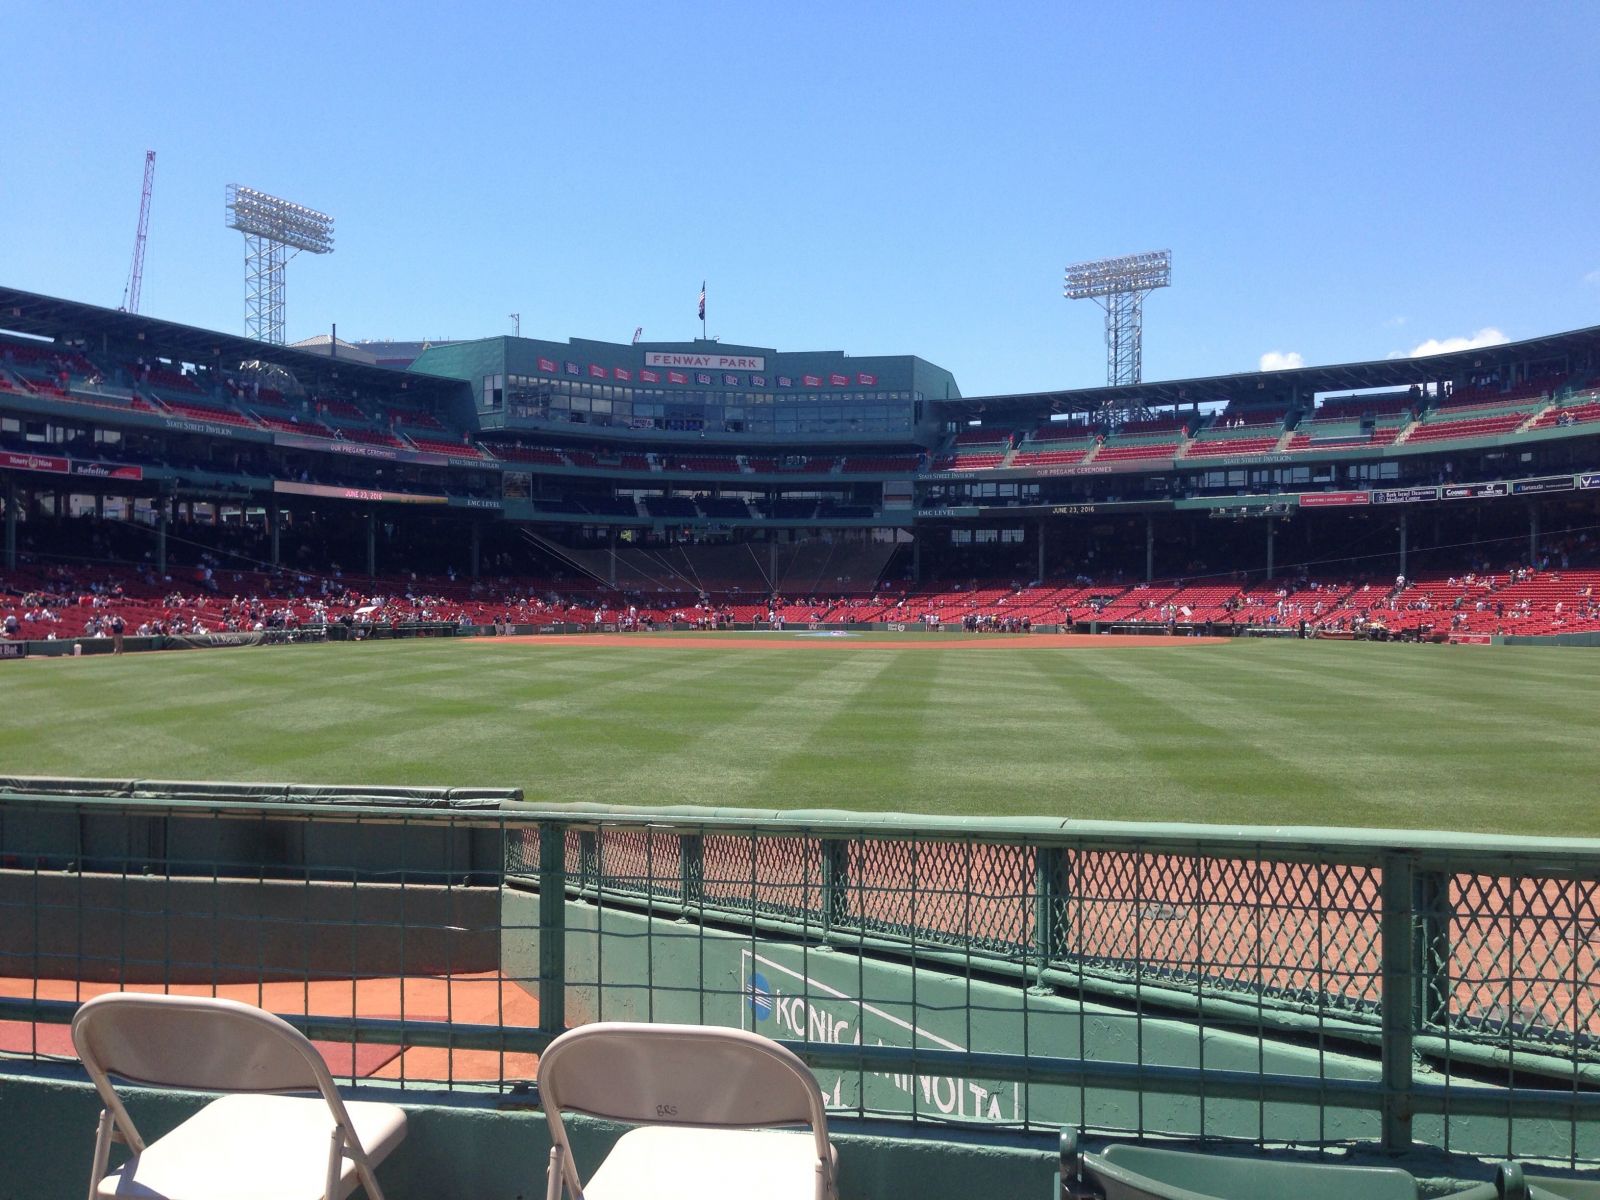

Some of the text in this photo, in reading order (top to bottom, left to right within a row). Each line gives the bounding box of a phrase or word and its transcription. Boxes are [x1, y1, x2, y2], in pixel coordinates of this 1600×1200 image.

[653, 355, 757, 368] FENWAY PARK
[1049, 468, 1076, 476] PREGAME
[1077, 466, 1112, 474] CEREMONIES
[345, 489, 359, 498] JUNE
[370, 492, 382, 500] 2016
[482, 500, 500, 508] LEVEL
